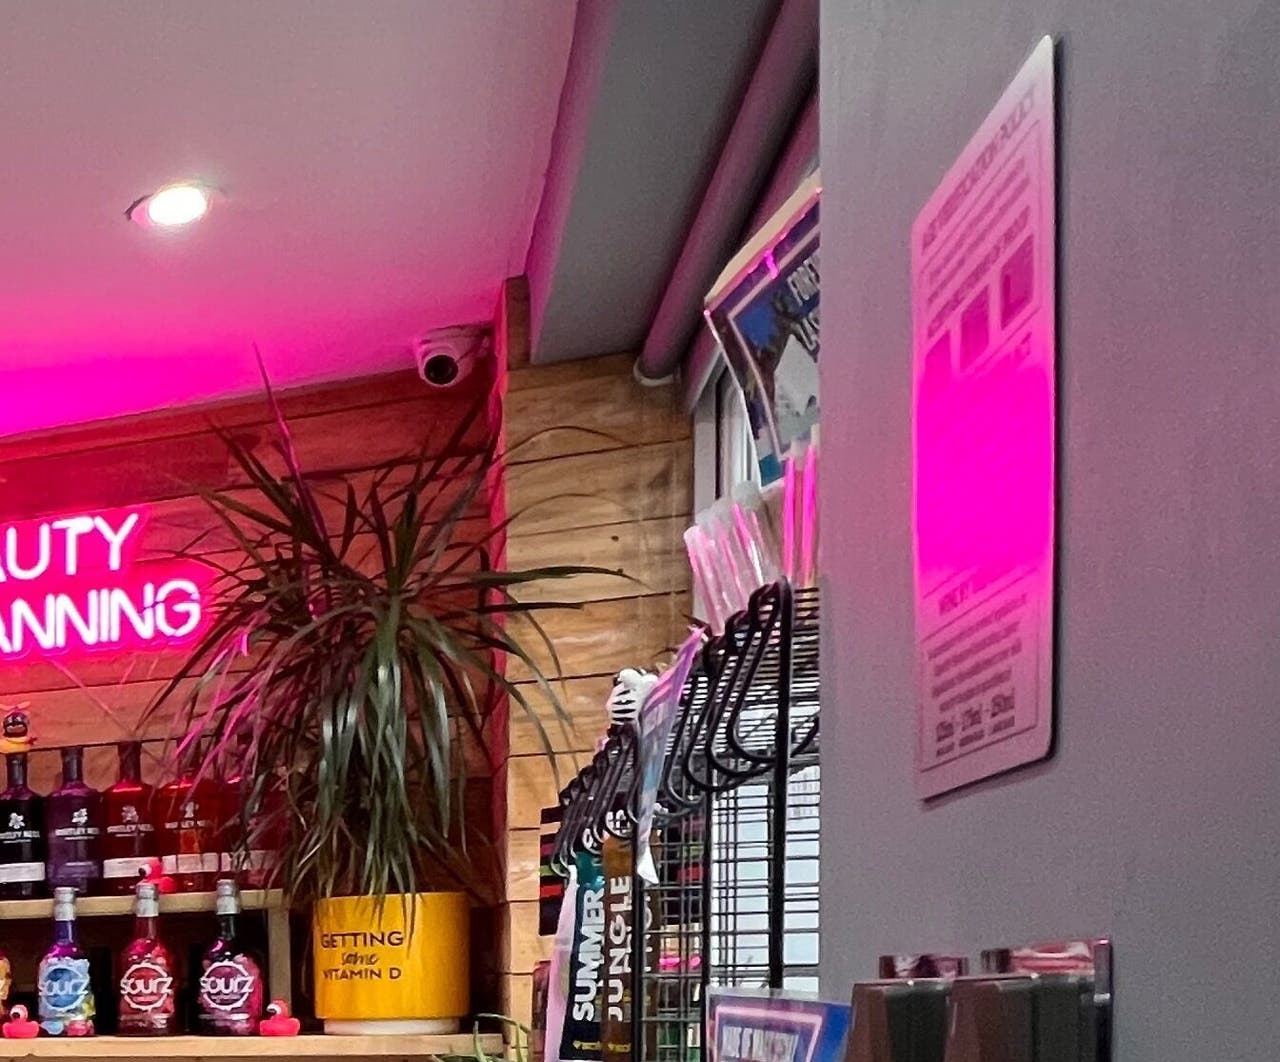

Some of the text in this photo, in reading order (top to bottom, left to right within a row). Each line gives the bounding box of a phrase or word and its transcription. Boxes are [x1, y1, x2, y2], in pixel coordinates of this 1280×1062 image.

[320, 931, 404, 948] GETTING
[322, 967, 402, 980] VITAMIN D
[572, 887, 605, 1021] SUMMER
[608, 875, 634, 1022] JUNGLE
